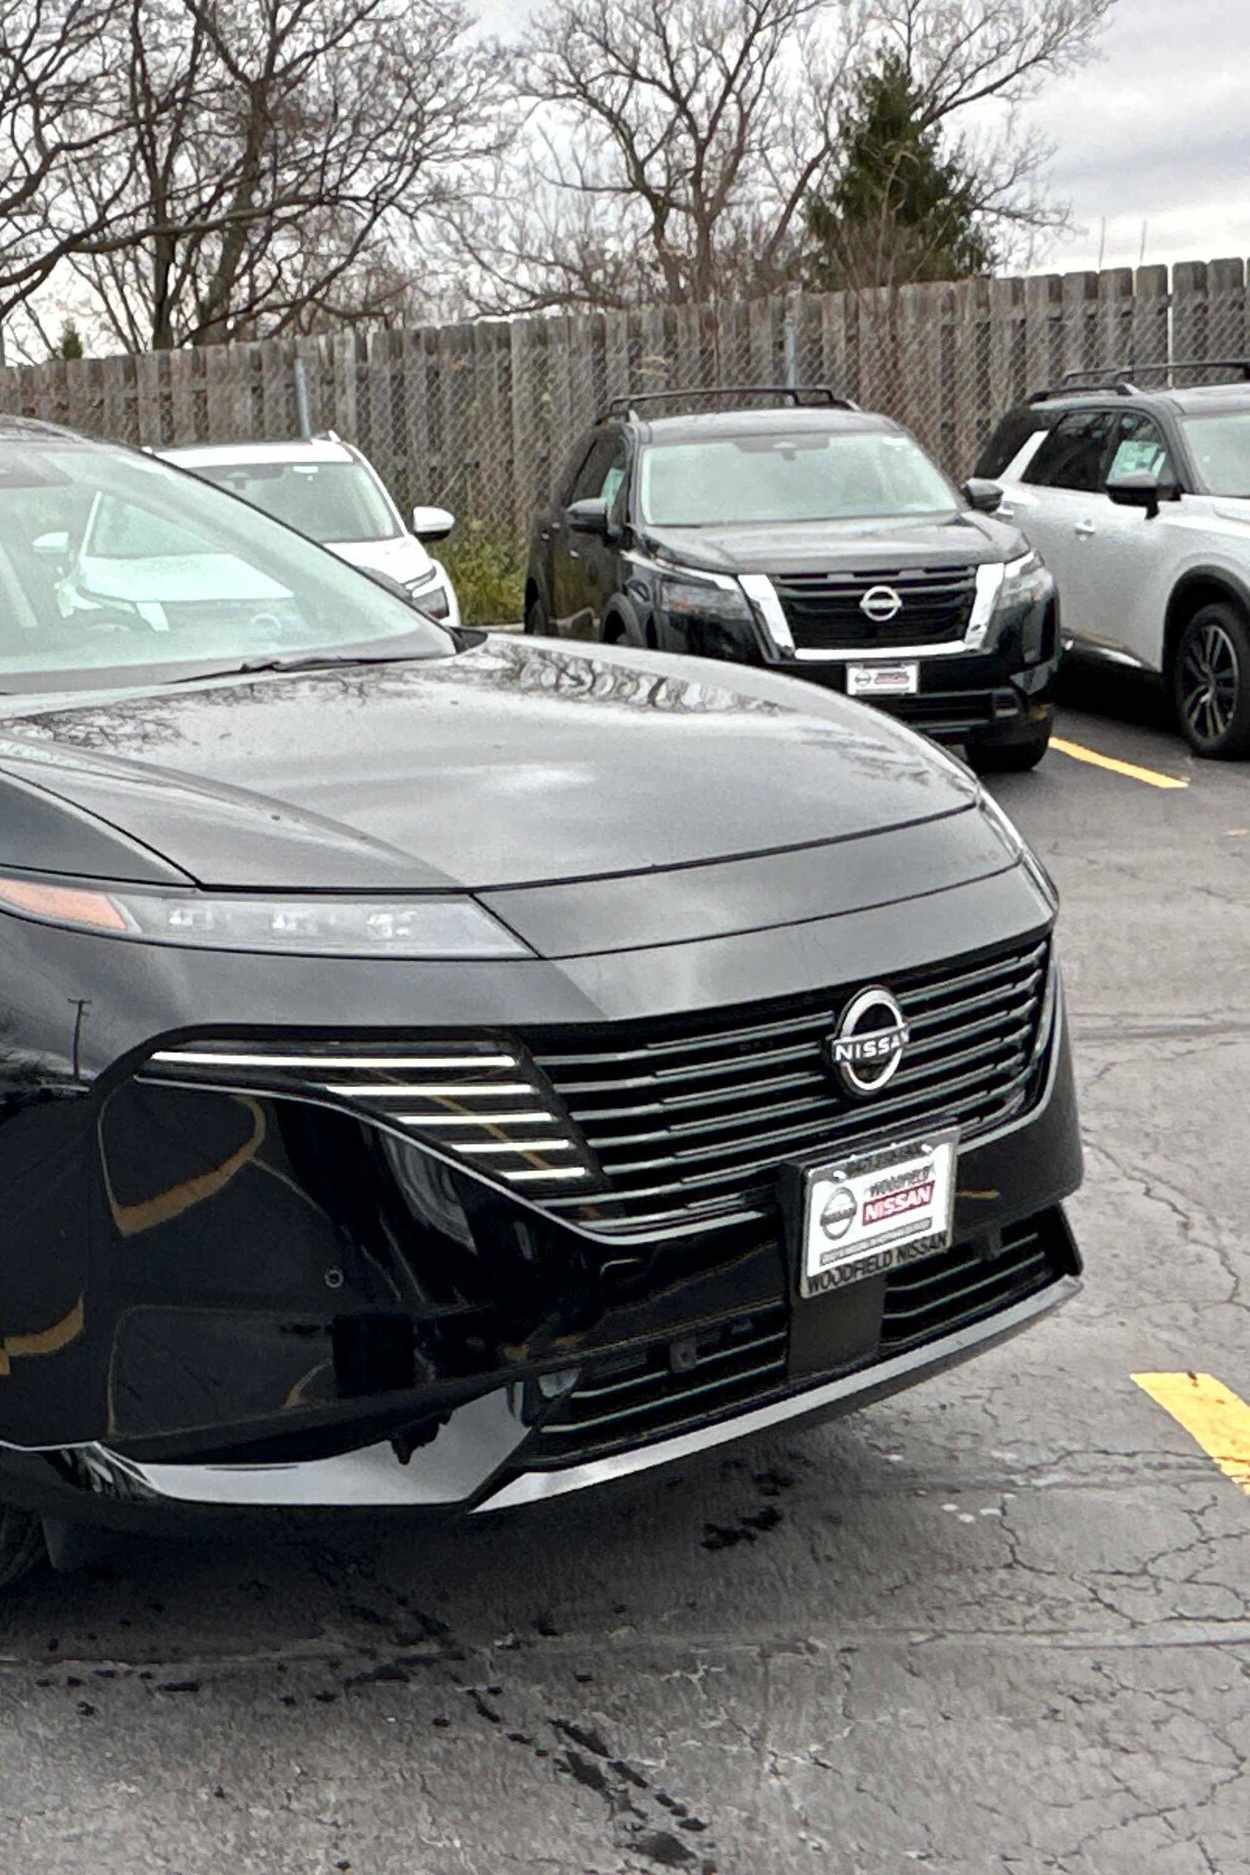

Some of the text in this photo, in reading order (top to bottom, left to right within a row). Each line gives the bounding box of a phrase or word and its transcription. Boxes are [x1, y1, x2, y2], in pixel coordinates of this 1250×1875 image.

[835, 1028, 909, 1061] NISSAN
[865, 1185, 931, 1222] NISSAN
[807, 1251, 893, 1294] WOODFIELD
